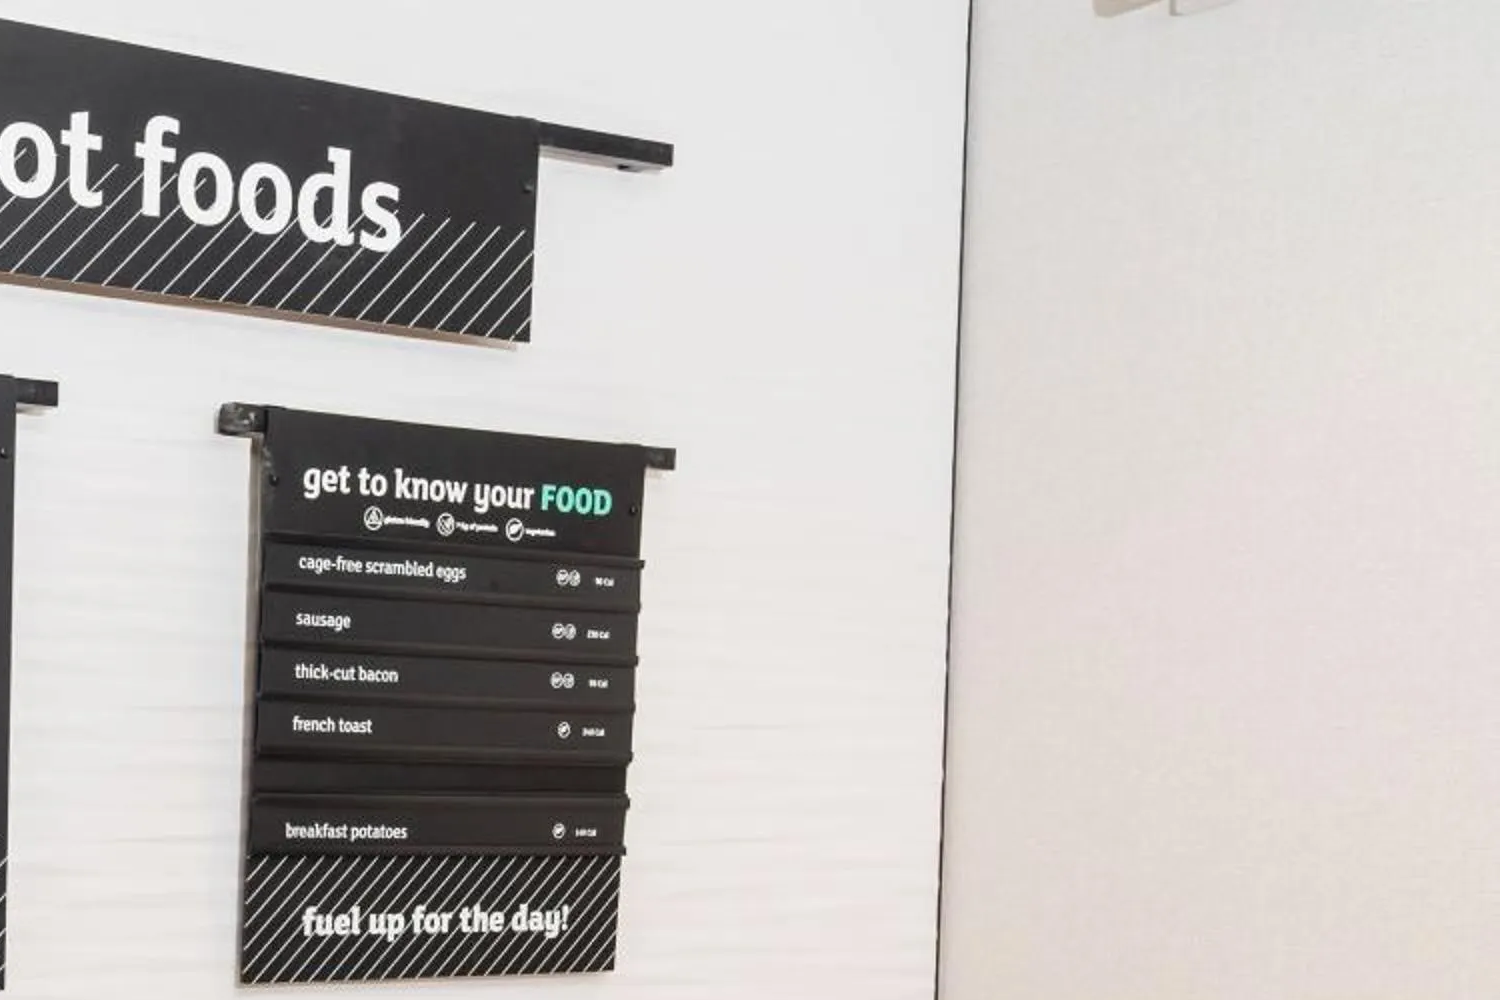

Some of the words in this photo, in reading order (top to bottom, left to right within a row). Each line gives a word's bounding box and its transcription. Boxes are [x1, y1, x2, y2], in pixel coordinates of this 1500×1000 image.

[133, 114, 402, 253] foods
[302, 465, 351, 499] get
[357, 467, 388, 497] to
[394, 468, 468, 504] know
[473, 482, 535, 514] your
[541, 484, 613, 516] FOOD
[298, 555, 363, 575] cage-free
[365, 560, 434, 578] scrambled
[436, 566, 467, 583] eggs
[295, 611, 351, 632] sausage
[294, 663, 356, 681] thick-cut
[358, 665, 399, 683] bacon
[292, 715, 335, 733] french
[338, 717, 373, 734] toast
[285, 821, 348, 840] breakfast
[350, 823, 408, 842] potatoes
[302, 903, 361, 937] fuel
[368, 912, 405, 943] up
[412, 904, 453, 935] for
[459, 903, 505, 934] the
[510, 902, 570, 939] day!
